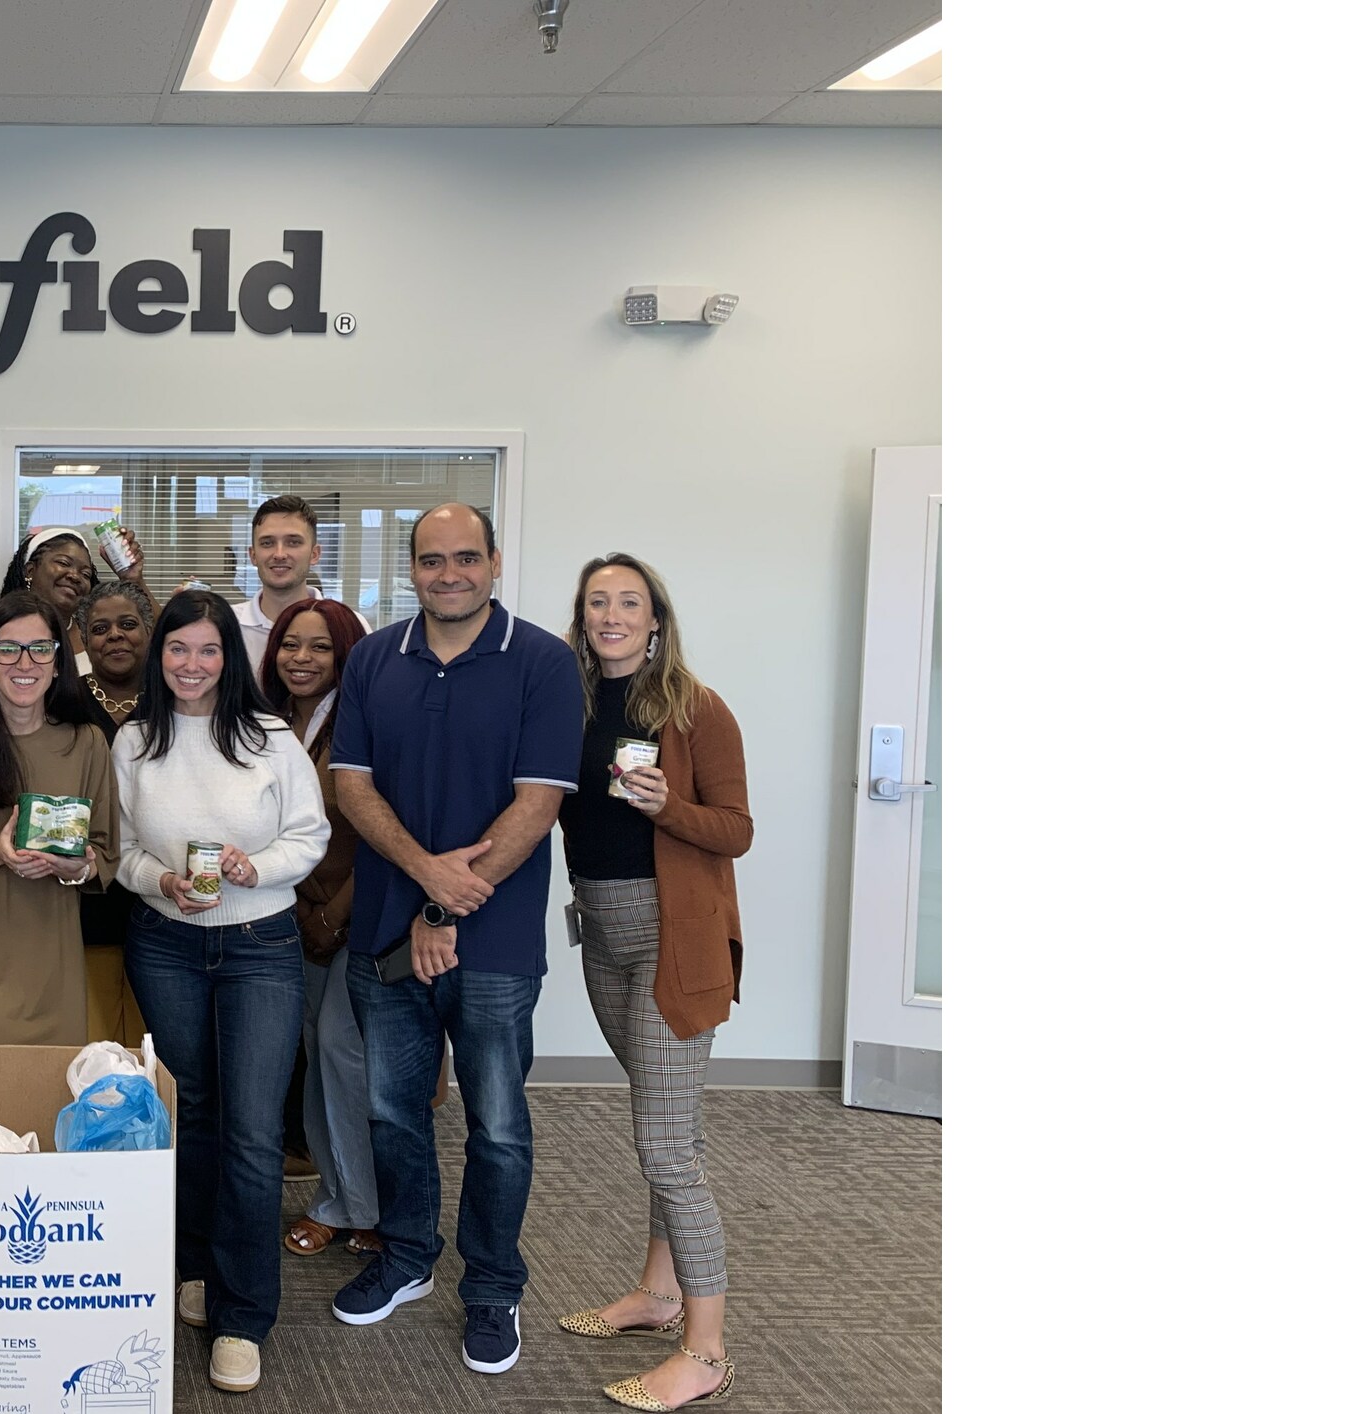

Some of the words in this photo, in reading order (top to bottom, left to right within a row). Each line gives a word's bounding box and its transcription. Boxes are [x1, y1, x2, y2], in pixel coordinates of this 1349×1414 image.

[46, 1200, 104, 1211] PENINSULA
[41, 1274, 75, 1288] WE
[79, 1273, 122, 1288] CAN
[37, 1293, 156, 1310] COMMUNITY
